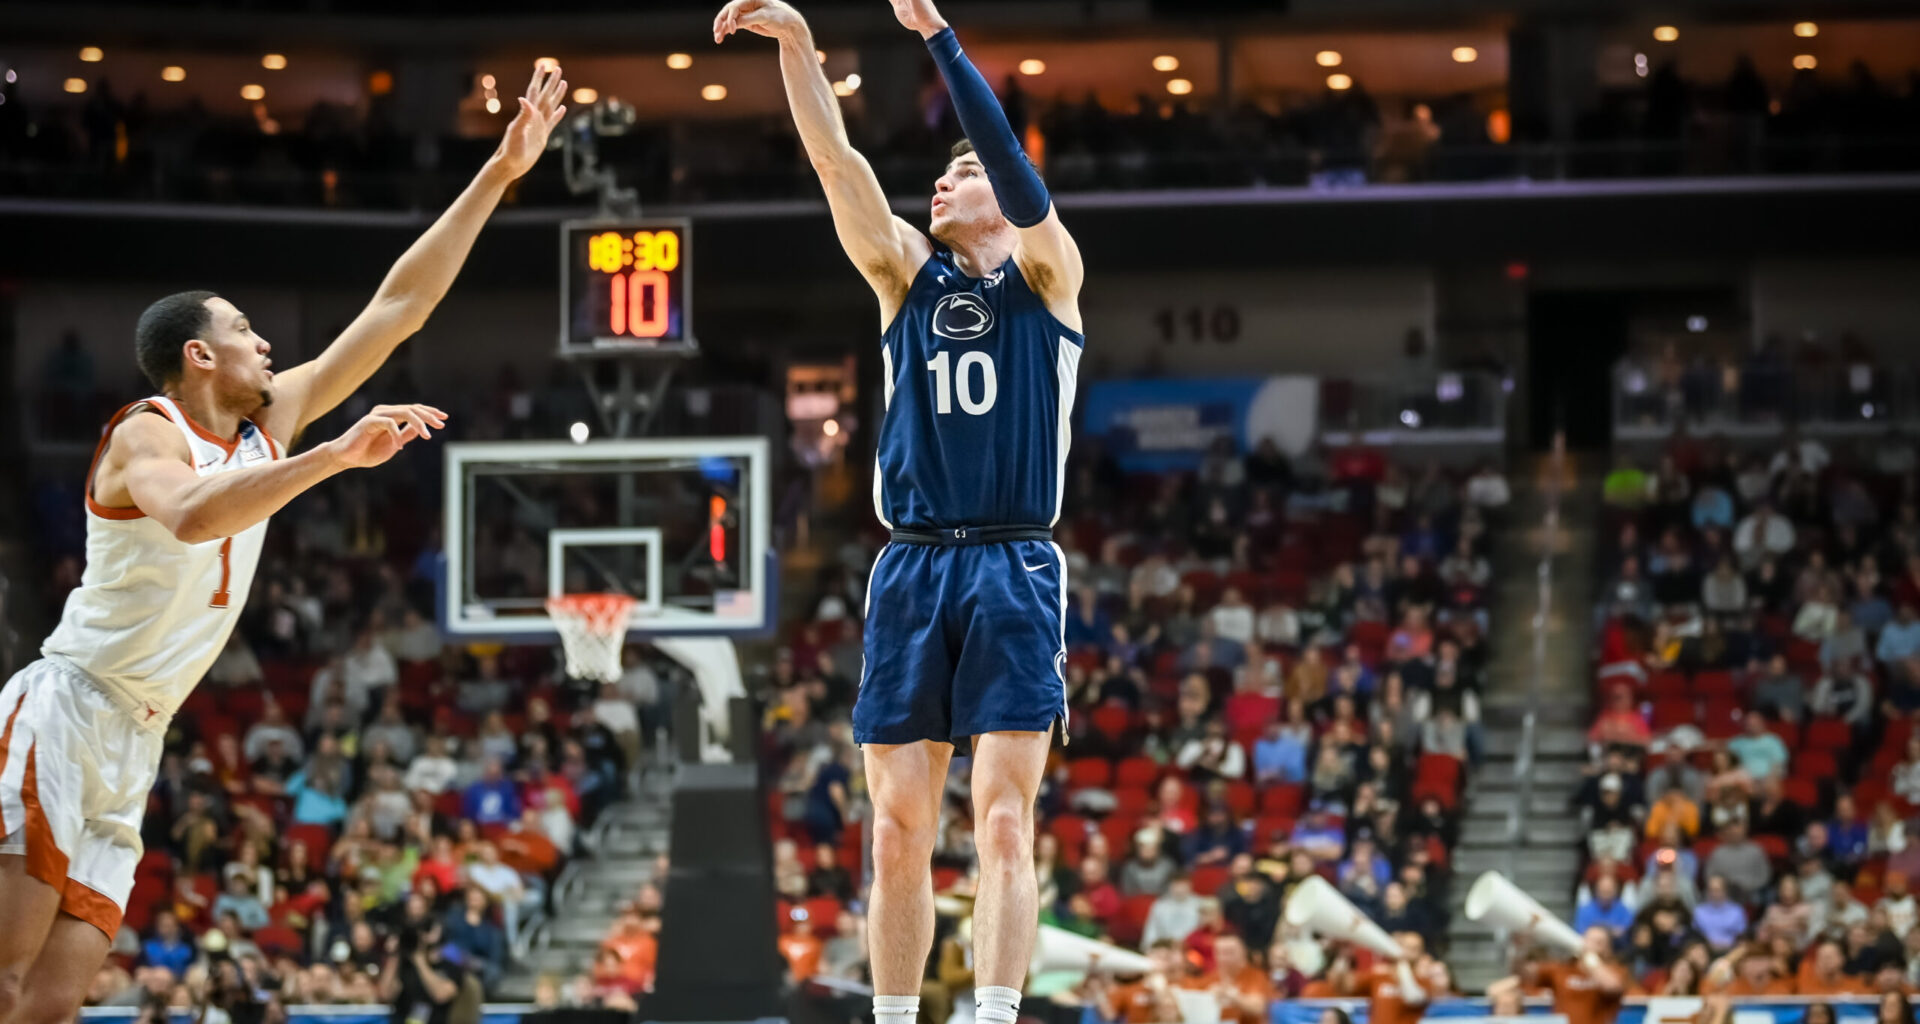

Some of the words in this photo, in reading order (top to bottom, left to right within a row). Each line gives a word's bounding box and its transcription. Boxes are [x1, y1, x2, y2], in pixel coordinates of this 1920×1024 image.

[589, 231, 679, 273] 18:30
[611, 270, 669, 338] 10
[1153, 305, 1242, 344] 110
[927, 350, 998, 416] 10
[208, 536, 233, 609] 1
